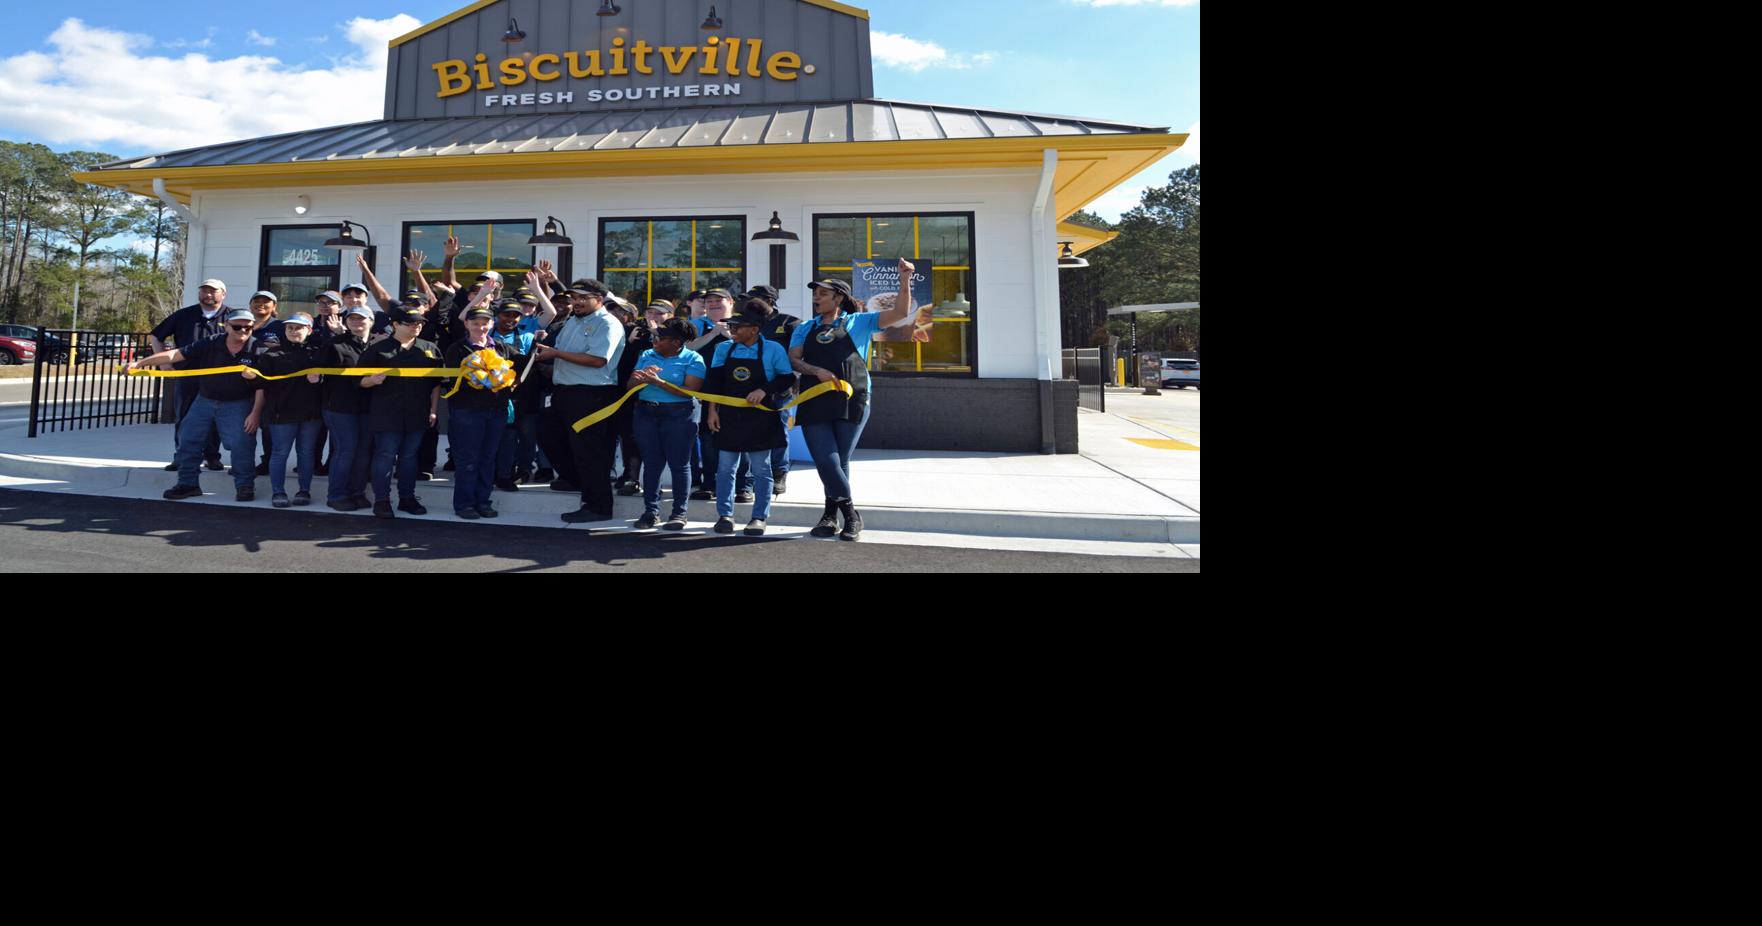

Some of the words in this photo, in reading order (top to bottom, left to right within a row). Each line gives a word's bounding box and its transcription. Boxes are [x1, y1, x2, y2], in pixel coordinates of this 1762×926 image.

[485, 92, 573, 107] FRESH
[587, 82, 741, 101] SOUTHERN
[288, 248, 319, 264] 4425
[861, 267, 925, 281] Cinnaon
